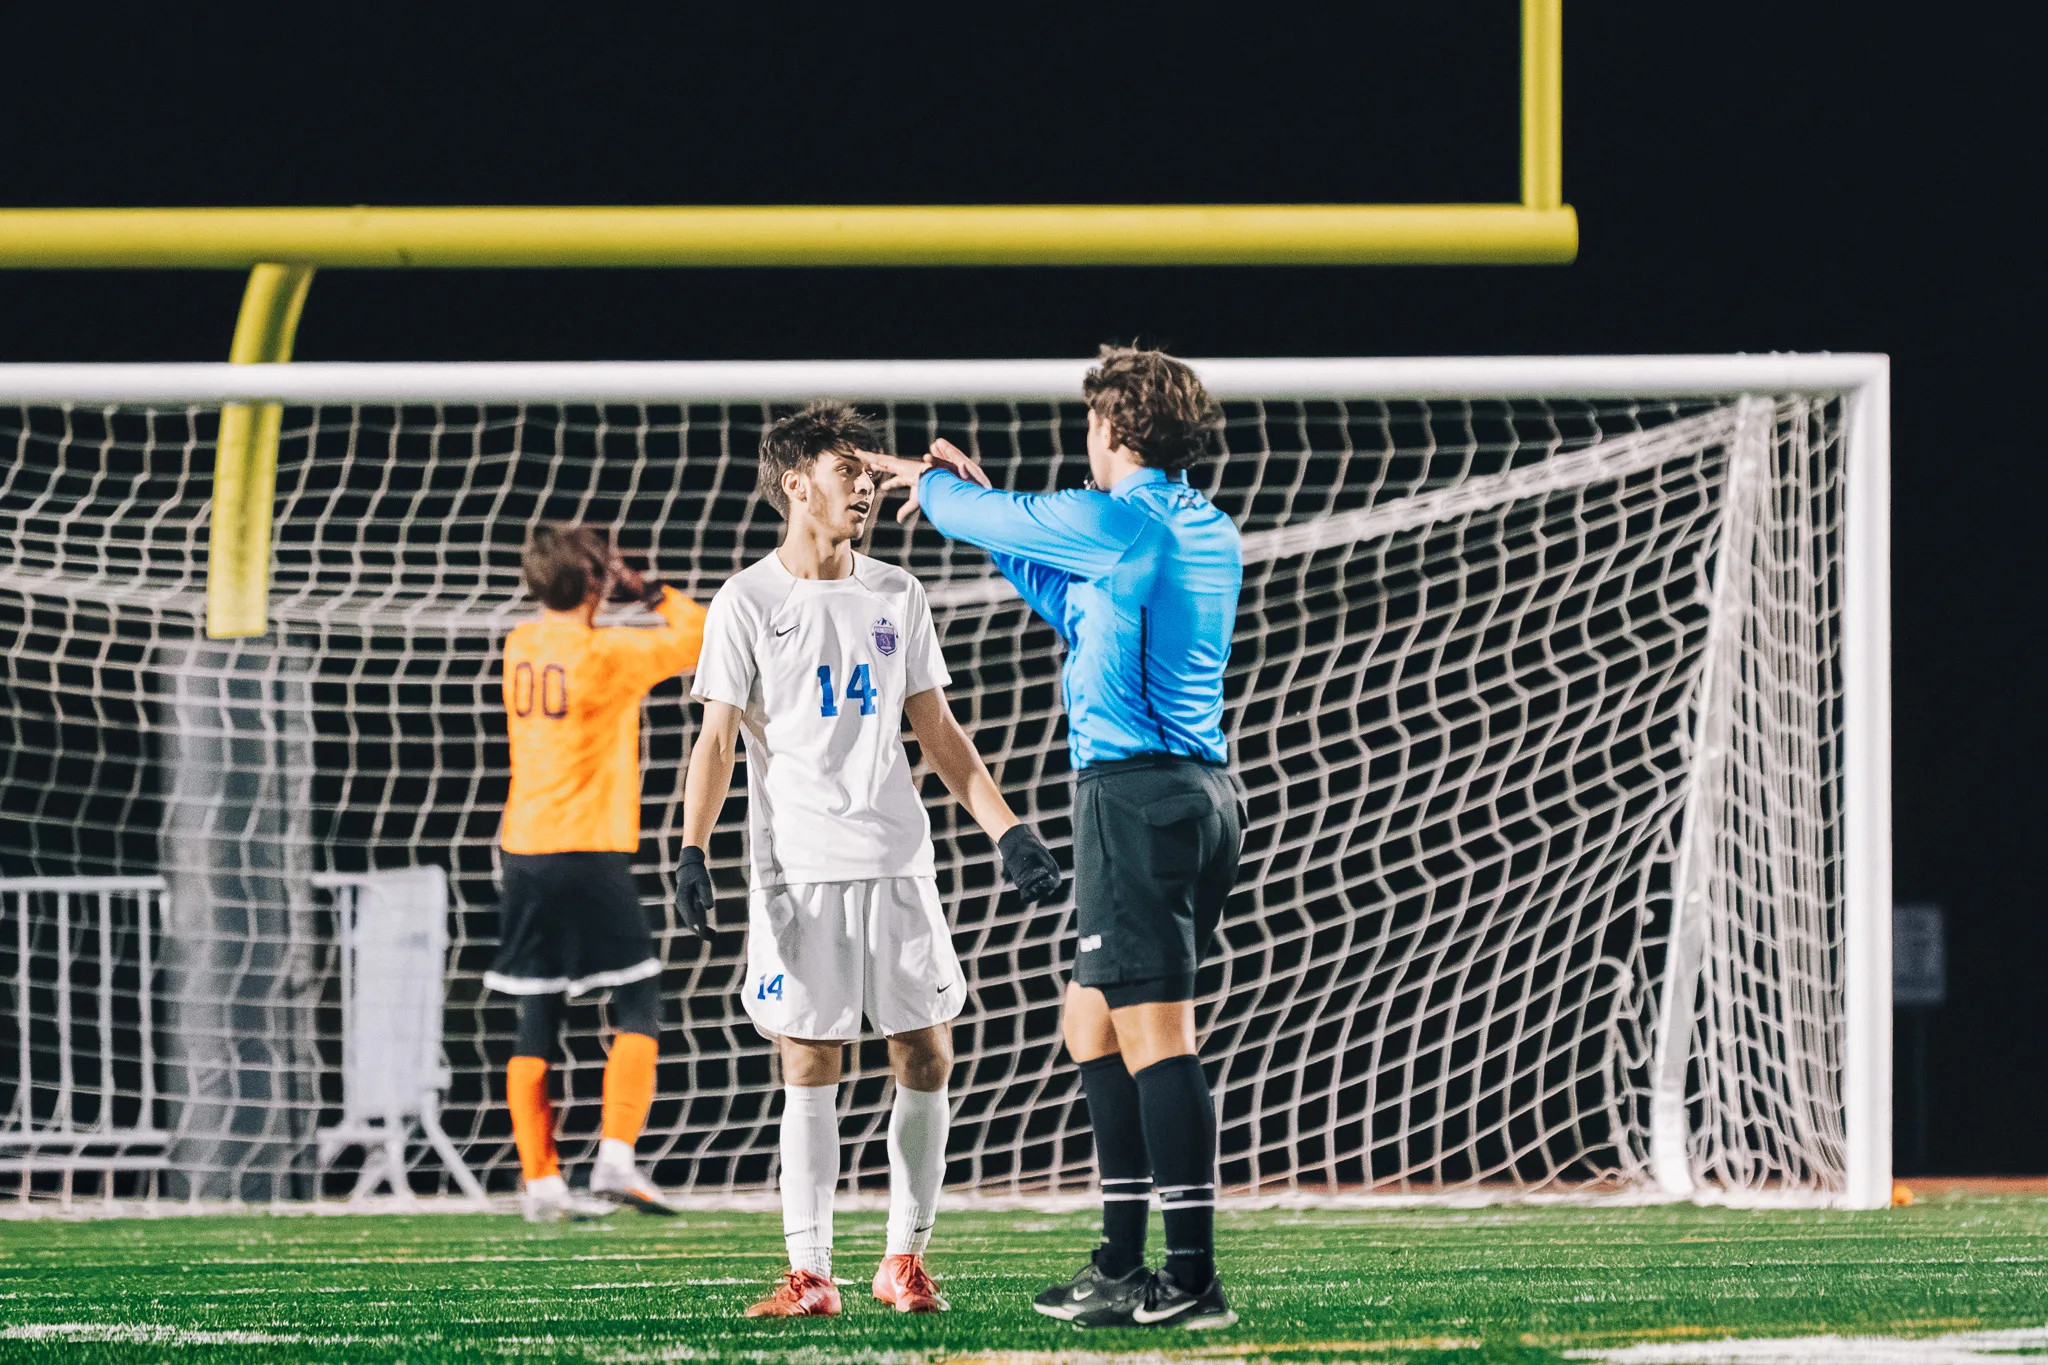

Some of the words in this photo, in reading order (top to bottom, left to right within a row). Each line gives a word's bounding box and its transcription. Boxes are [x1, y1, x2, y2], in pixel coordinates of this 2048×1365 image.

[513, 661, 568, 720] 00
[817, 663, 877, 717] 14
[757, 973, 784, 1001] 14
